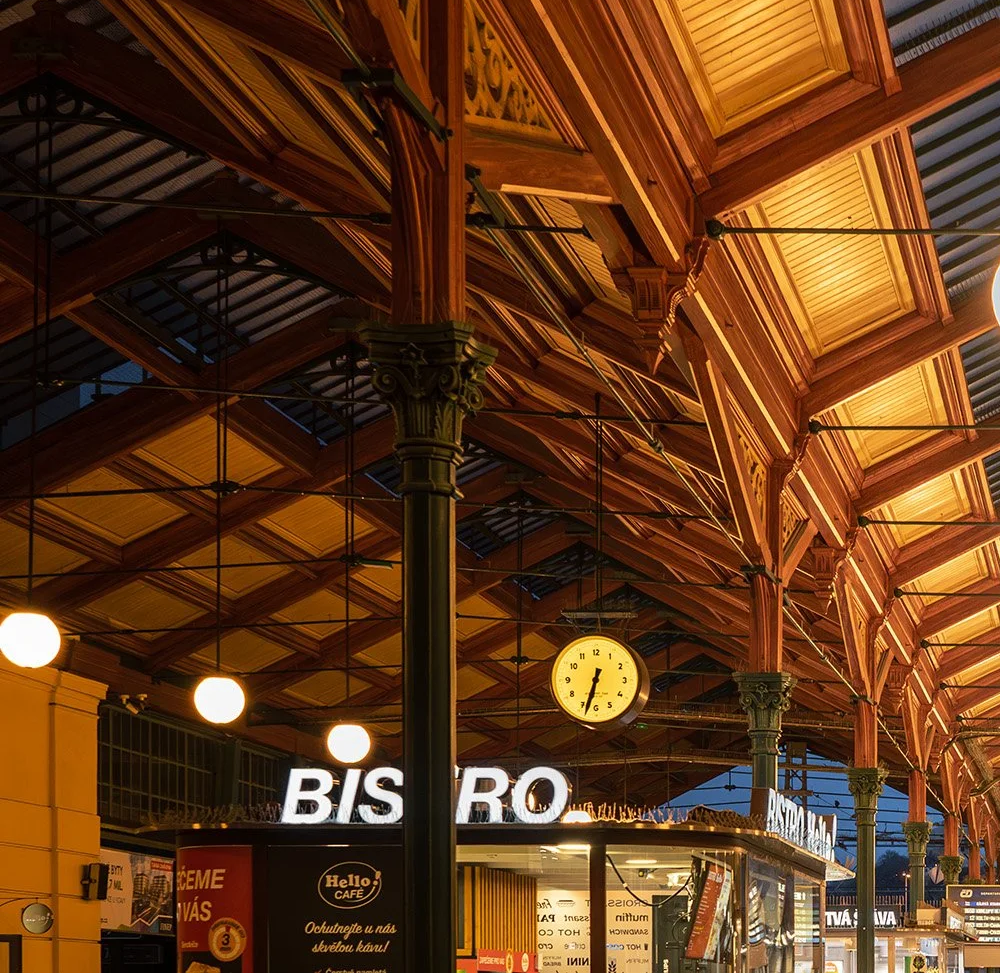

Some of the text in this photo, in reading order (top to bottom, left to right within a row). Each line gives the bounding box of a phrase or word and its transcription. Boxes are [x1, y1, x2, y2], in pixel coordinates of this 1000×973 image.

[281, 766, 568, 824] BISRO
[766, 788, 804, 846] BISTRO
[334, 887, 364, 900] CAFÉ
[183, 896, 212, 922] VÁS
[222, 934, 230, 946] 3
[304, 921, 397, 940] Ochutnejte u nás
[312, 940, 390, 952] skvělou kávu!
